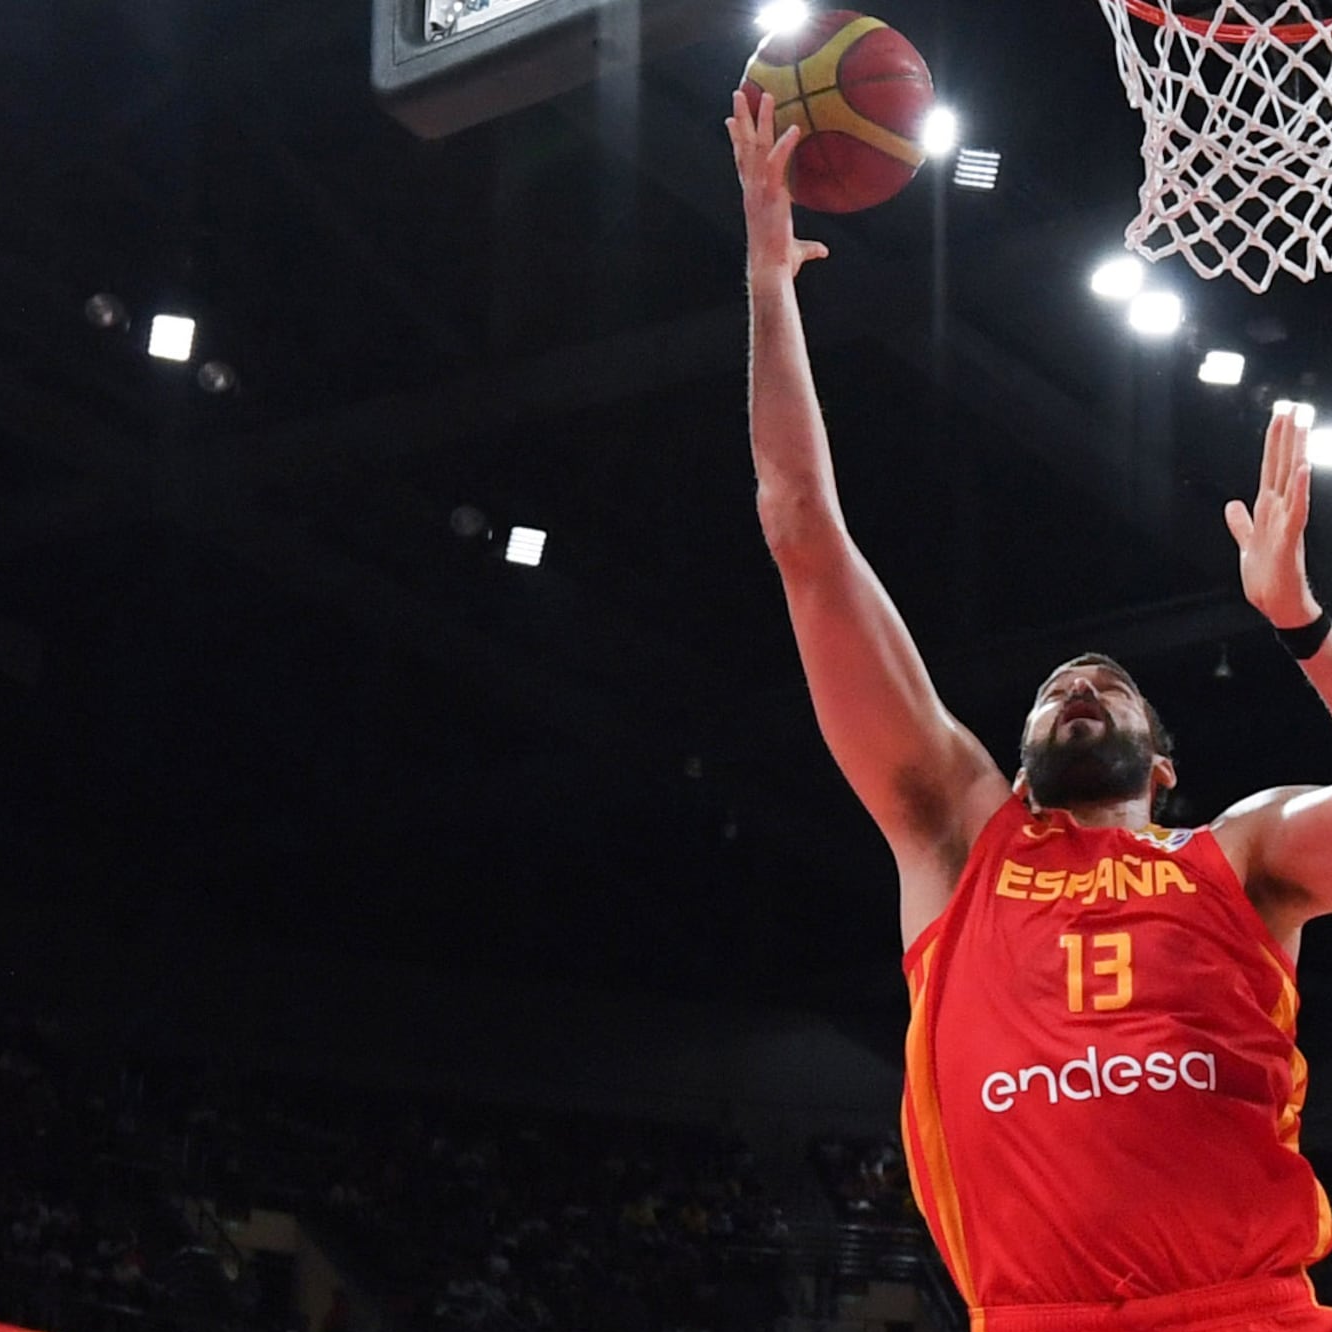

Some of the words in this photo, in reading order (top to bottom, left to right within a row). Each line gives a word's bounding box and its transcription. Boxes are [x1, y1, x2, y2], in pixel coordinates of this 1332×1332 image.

[996, 855, 1196, 904] ESPAÑA
[1060, 932, 1133, 1012] 13
[981, 1046, 1217, 1112] endesa
